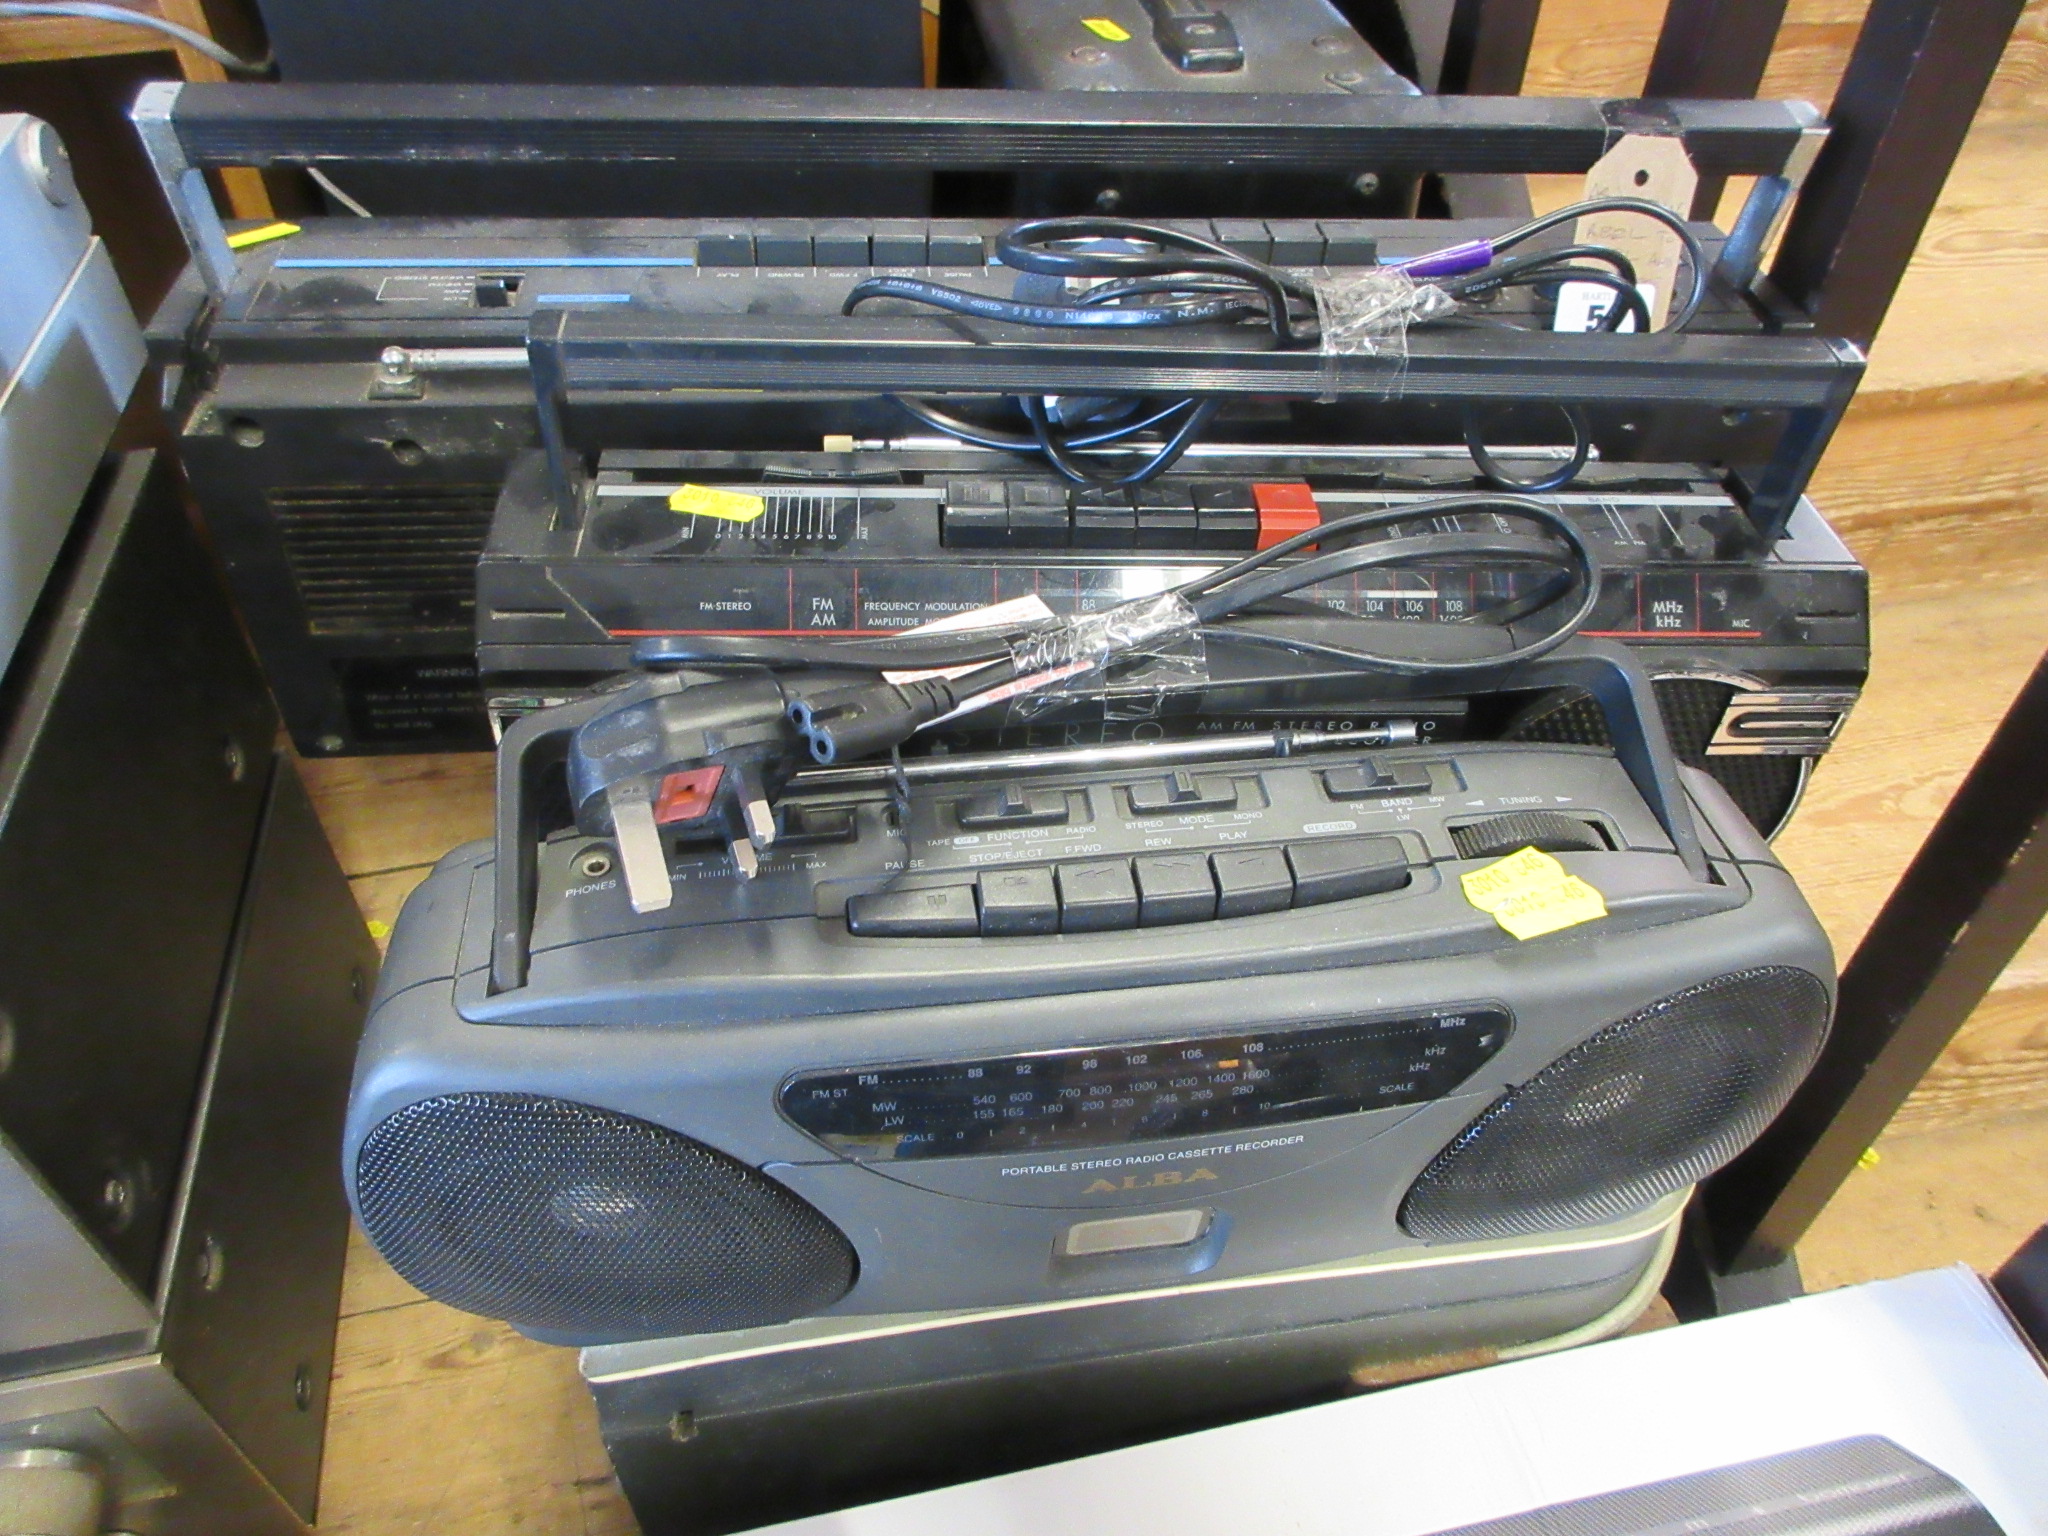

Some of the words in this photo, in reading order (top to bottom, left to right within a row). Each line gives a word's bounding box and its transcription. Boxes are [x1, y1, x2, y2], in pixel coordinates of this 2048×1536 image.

[931, 288, 962, 302] VS502
[754, 488, 804, 496] VOLUME
[860, 526, 868, 541] MAX
[811, 597, 834, 611] FM
[864, 602, 921, 611] FREQUENCY
[925, 601, 988, 611] MODULATION
[1081, 599, 1096, 610] 88
[1327, 600, 1345, 611] 102
[1366, 600, 1384, 613] 104
[1405, 600, 1424, 613] 106
[1445, 600, 1464, 613] 108
[1653, 600, 1684, 614] MHz
[810, 613, 837, 626] AM
[867, 617, 920, 627] AMPLITUDE
[1655, 615, 1682, 628] kHz
[1731, 619, 1751, 628] MIC
[1198, 722, 1223, 731] AM
[1233, 720, 1257, 731] FM
[1272, 720, 1354, 732] STEREO
[1350, 803, 1364, 811] FM
[1381, 798, 1413, 808] BAND
[1429, 796, 1445, 804] MW
[1498, 796, 1543, 805] TUNING
[1125, 820, 1164, 830] STEREO
[1179, 814, 1215, 825] MODE
[1233, 811, 1263, 821] MONO
[1066, 825, 1096, 835] RADIO
[1306, 822, 1354, 832] RECORD
[987, 828, 1049, 842] FUNCTION
[1219, 831, 1248, 841] PLAY
[927, 838, 950, 847] TAPE
[1144, 838, 1172, 847] REW
[969, 849, 1043, 863] STOP/EJECT
[805, 861, 827, 869] MAX
[669, 873, 687, 882] MIN
[565, 880, 617, 898] PHONES
[858, 1075, 879, 1086] FM
[968, 1069, 983, 1078] 88
[1016, 1065, 1032, 1075] 92
[1082, 1059, 1098, 1069] 98
[1126, 1054, 1148, 1065] 102
[1181, 1050, 1203, 1060] 106
[1242, 1043, 1264, 1053] 108
[1440, 1018, 1466, 1029] MHz
[872, 1102, 897, 1113] MW
[973, 1095, 996, 1105] 540
[1009, 1092, 1033, 1102] 600
[1058, 1088, 1081, 1098] 700
[1089, 1085, 1112, 1095] 800
[1128, 1081, 1157, 1092] 1000
[1169, 1077, 1198, 1088] 1200
[1207, 1072, 1236, 1083] 1400
[1242, 1069, 1270, 1081] 1600
[1425, 1046, 1447, 1057] kHz
[812, 1090, 830, 1099] FM
[833, 1088, 848, 1098] ST
[884, 1116, 904, 1127] LW
[973, 1109, 995, 1119] 155
[1002, 1106, 1024, 1117] 165
[1042, 1104, 1064, 1114] 180
[1081, 1100, 1104, 1111] 200
[1112, 1098, 1134, 1108] 220
[1156, 1093, 1178, 1104] 245
[1191, 1089, 1213, 1100] 265
[1232, 1085, 1254, 1095] 280
[1409, 1062, 1430, 1073] kHz
[896, 1132, 935, 1144] SCALE
[1259, 1102, 1271, 1110] 10
[1379, 1082, 1415, 1095] SCALE
[1002, 1163, 1068, 1177] PORTABLE
[1071, 1158, 1122, 1171] STEREO
[1125, 1153, 1164, 1165] RADIO
[1168, 1145, 1232, 1161] CASSETTE
[1235, 1135, 1305, 1152] RECORDER
[1082, 1168, 1218, 1195] ALBA
